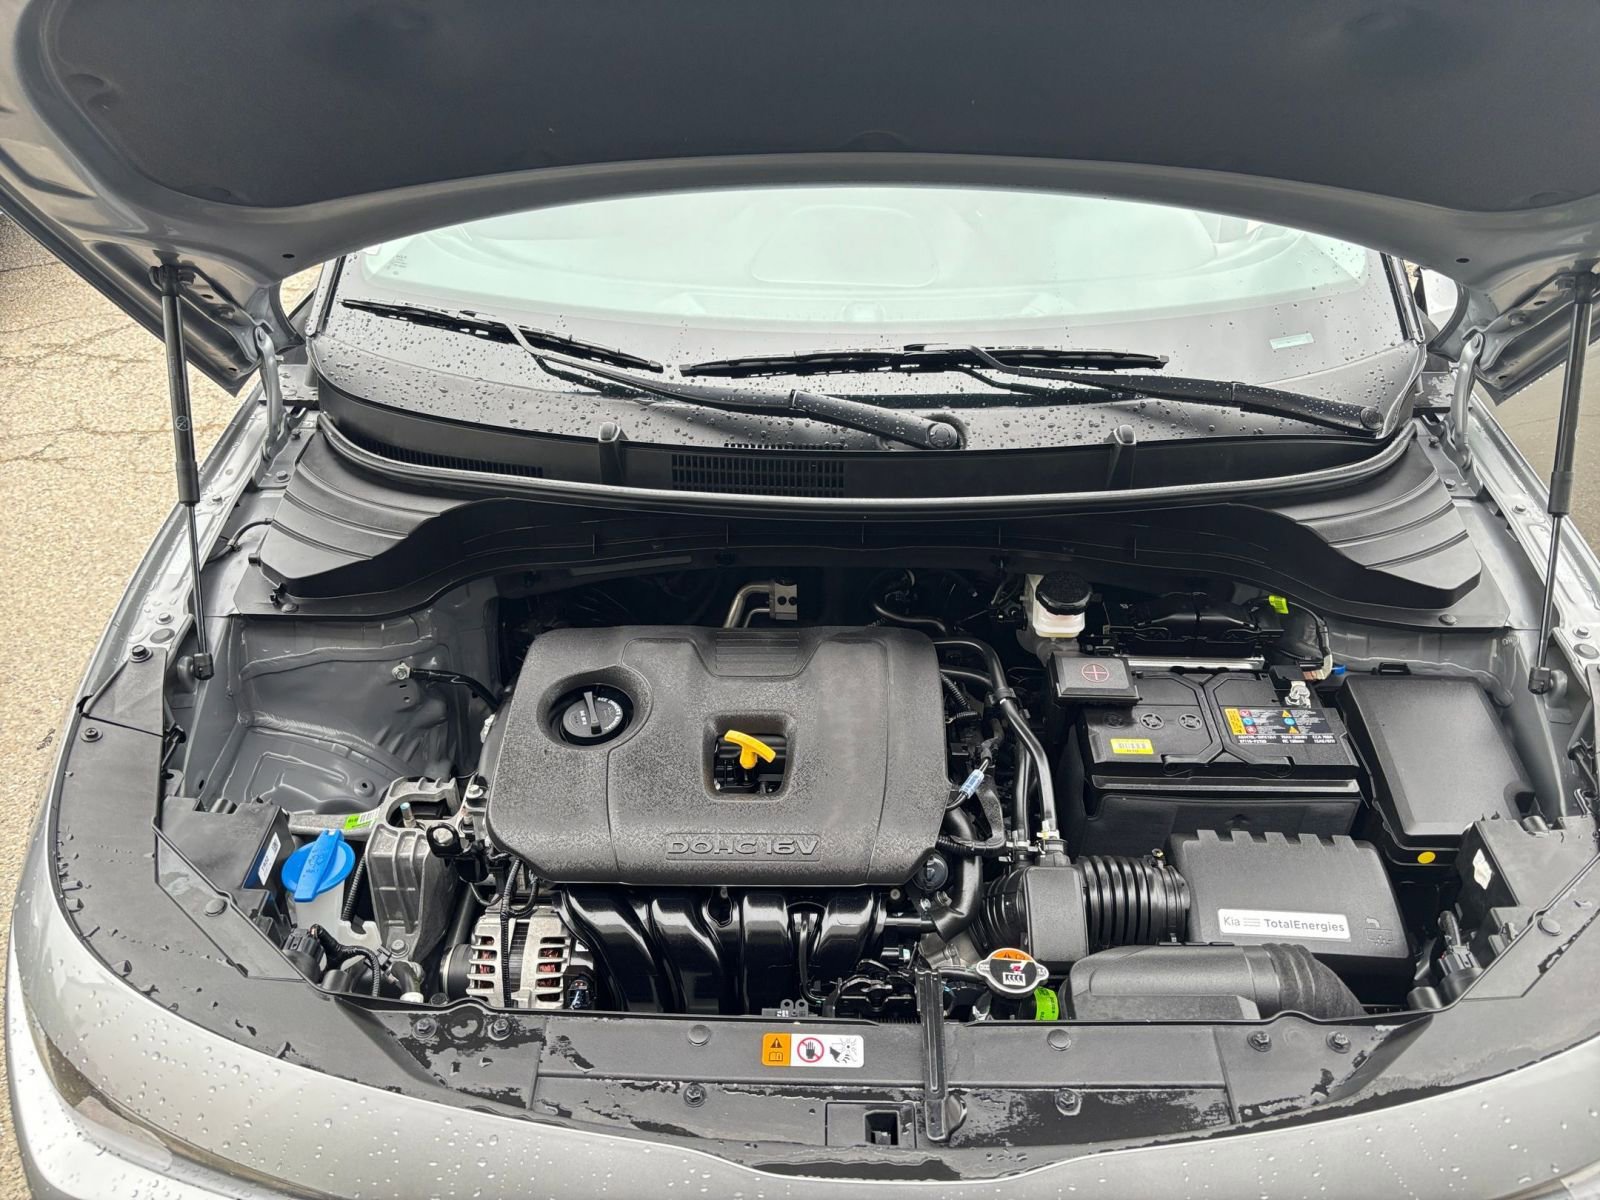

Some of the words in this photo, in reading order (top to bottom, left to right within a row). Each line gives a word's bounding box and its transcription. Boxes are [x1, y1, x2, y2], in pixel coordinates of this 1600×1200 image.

[667, 840, 758, 855] DOHC
[766, 840, 819, 856] 16V
[1223, 916, 1241, 927] Kia
[1263, 918, 1345, 933] TotalEnergies
